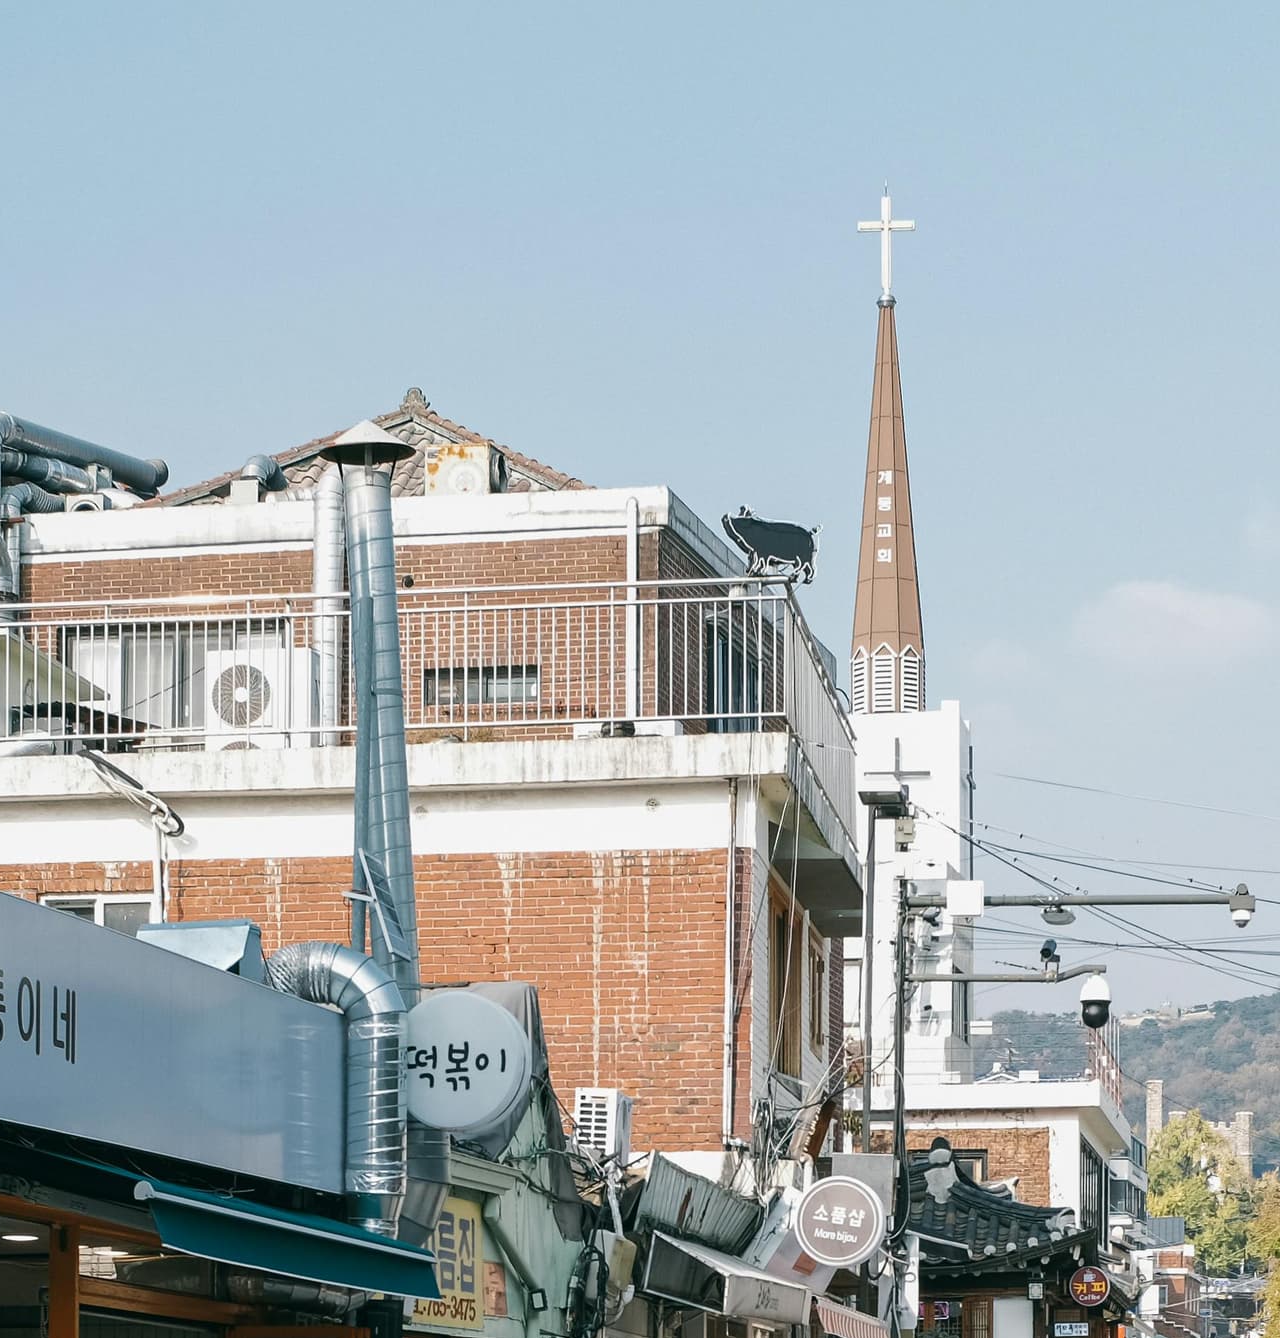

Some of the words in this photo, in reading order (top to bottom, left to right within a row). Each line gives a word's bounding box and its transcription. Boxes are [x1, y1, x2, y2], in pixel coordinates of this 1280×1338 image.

[407, 1041, 506, 1092] 떡볶이
[812, 1203, 866, 1228] 소품샵
[424, 1211, 475, 1293] 름집
[1072, 1281, 1106, 1295] 커피
